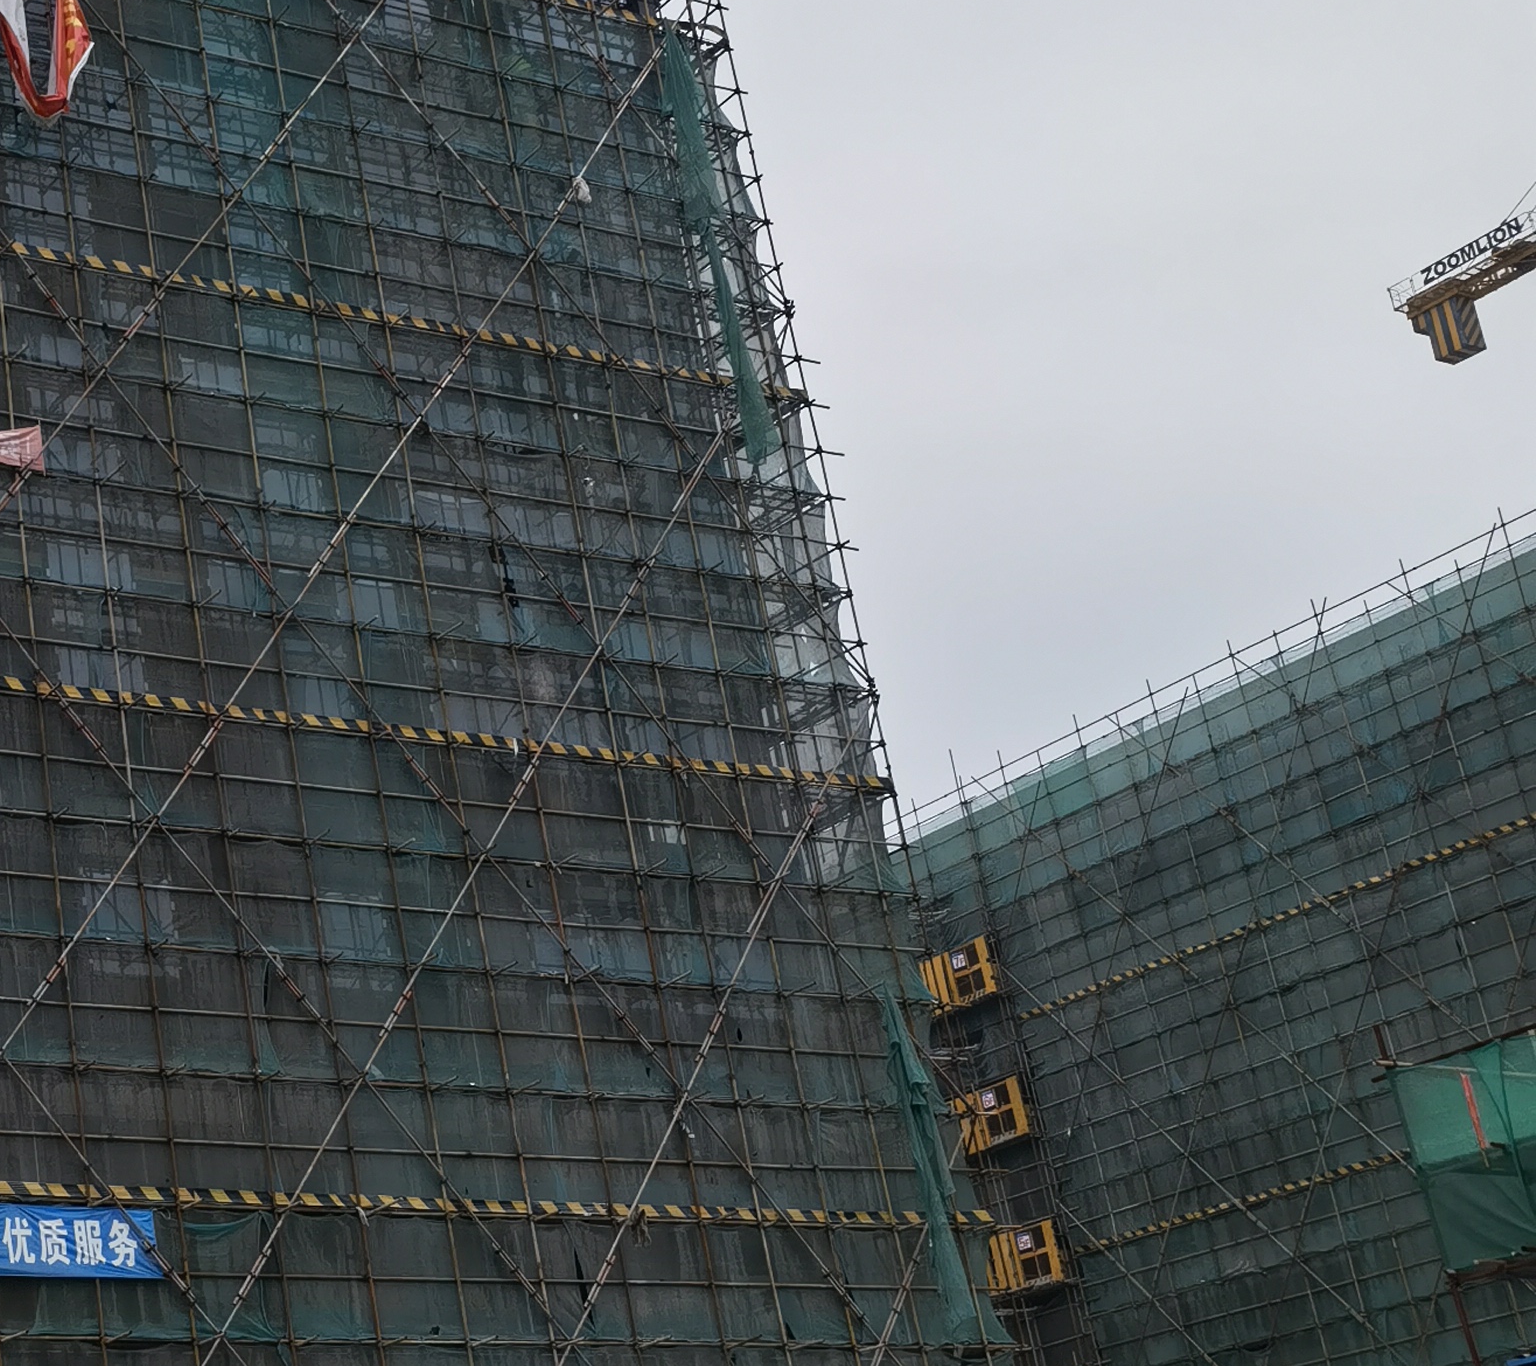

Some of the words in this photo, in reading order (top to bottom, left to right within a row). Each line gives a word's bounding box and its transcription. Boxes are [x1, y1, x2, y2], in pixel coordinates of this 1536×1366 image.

[1420, 217, 1524, 285] ZOOMLION
[2, 1216, 139, 1267] 优质服务
